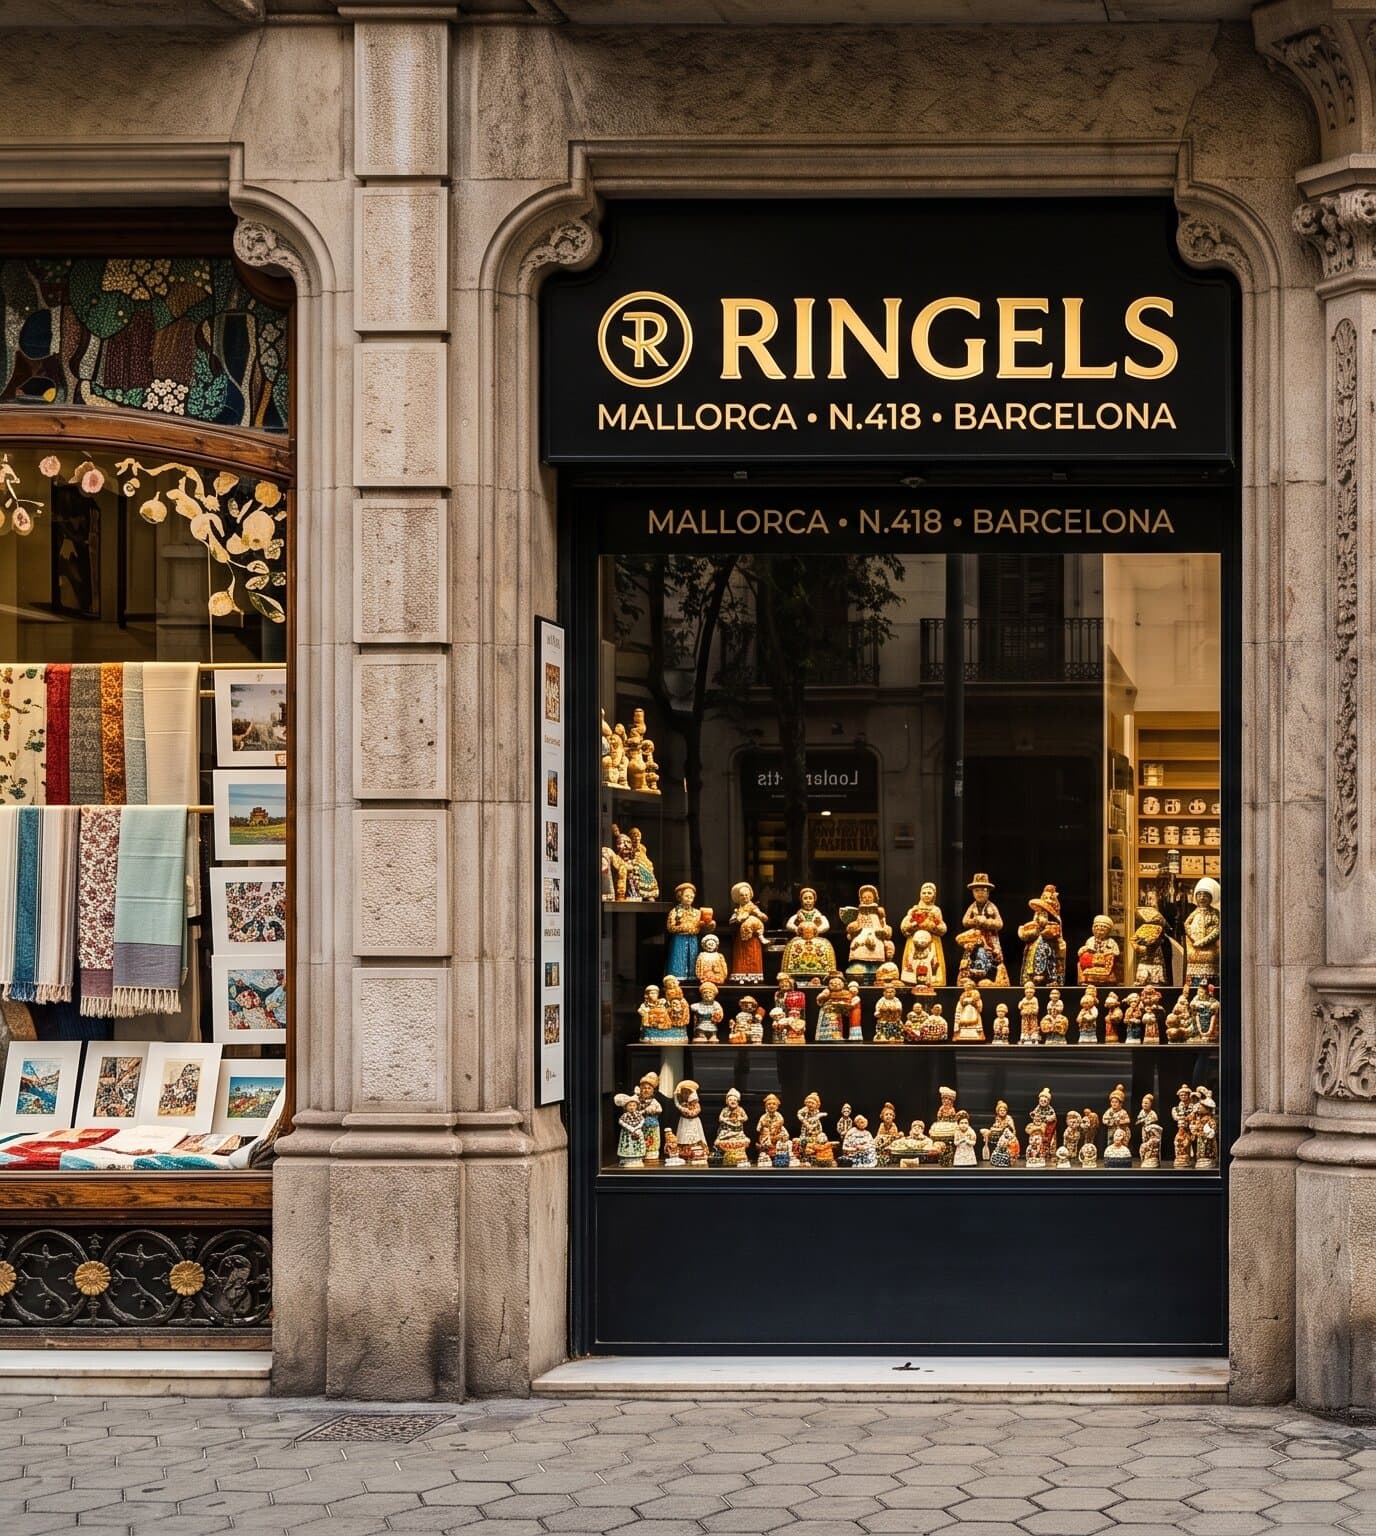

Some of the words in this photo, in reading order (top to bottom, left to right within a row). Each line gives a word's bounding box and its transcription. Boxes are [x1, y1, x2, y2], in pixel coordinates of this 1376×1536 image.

[720, 297, 1178, 380] RINGELS
[599, 404, 797, 430] MALLORCA
[830, 403, 921, 429] N.418
[955, 403, 1176, 430] BARCELONA
[648, 509, 829, 534] MALLORCA
[860, 509, 942, 533] N.418
[974, 509, 1174, 533] BARCELONA
